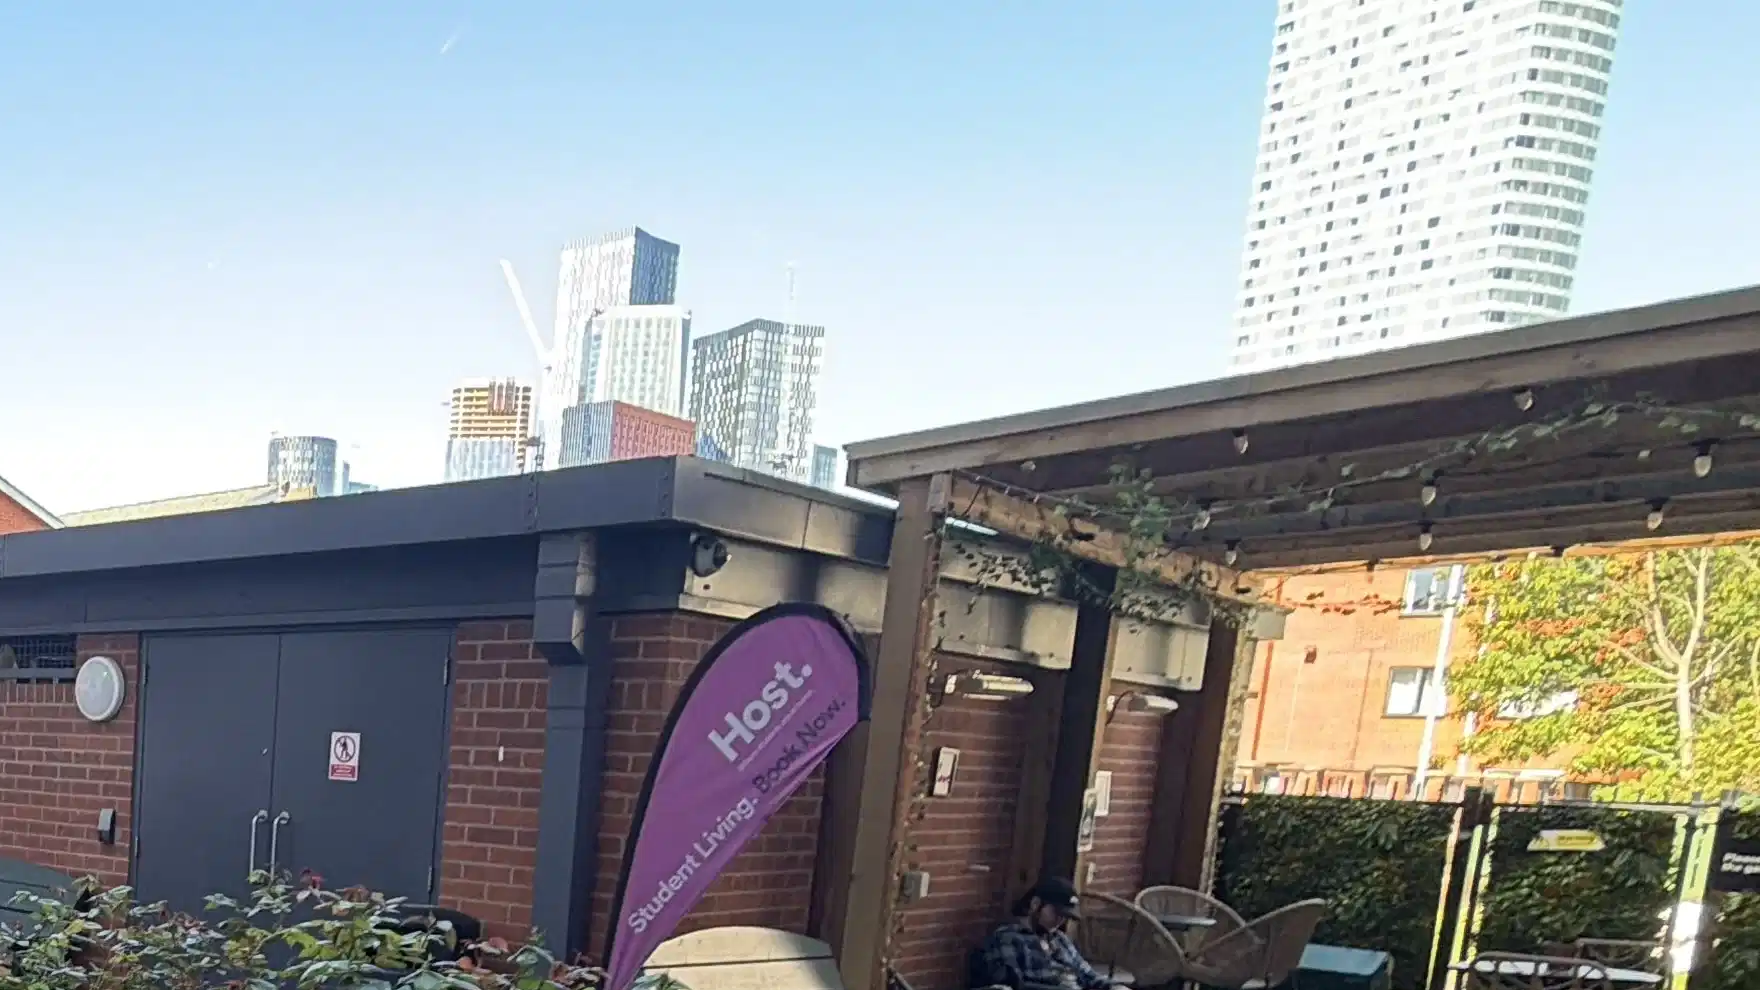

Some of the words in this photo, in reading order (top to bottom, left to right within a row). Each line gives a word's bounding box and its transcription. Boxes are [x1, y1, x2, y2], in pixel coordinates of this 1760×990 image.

[707, 660, 813, 763] Host.
[628, 854, 701, 935] Student
[693, 795, 759, 859] Living.
[751, 742, 797, 794] Book
[796, 699, 846, 743] Now.
